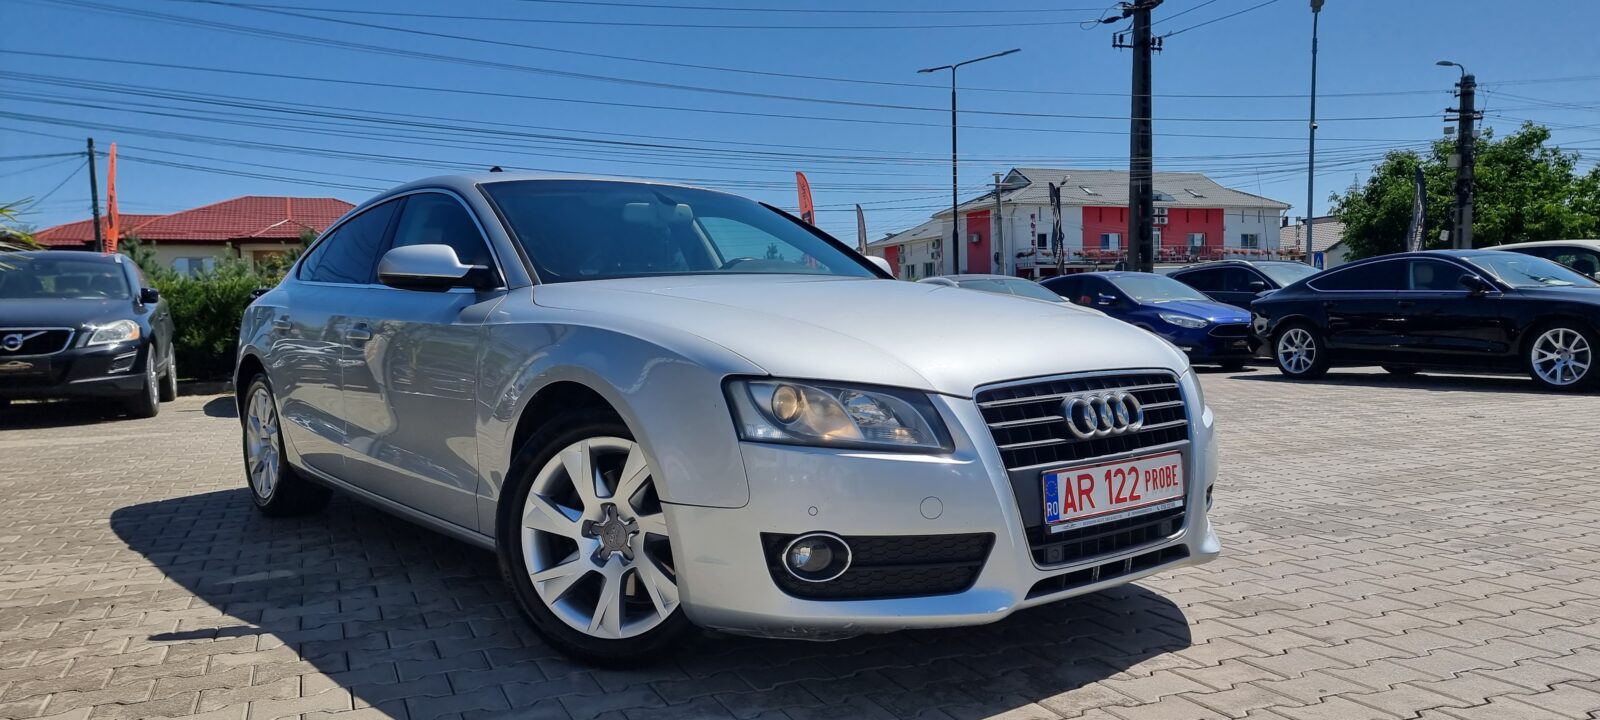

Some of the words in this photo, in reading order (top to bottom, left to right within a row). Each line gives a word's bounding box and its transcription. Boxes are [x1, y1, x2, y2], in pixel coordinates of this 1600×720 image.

[1063, 473, 1096, 514] AR
[1104, 466, 1141, 505] 122
[1144, 464, 1179, 492] PROBE
[1047, 501, 1059, 517] RO
